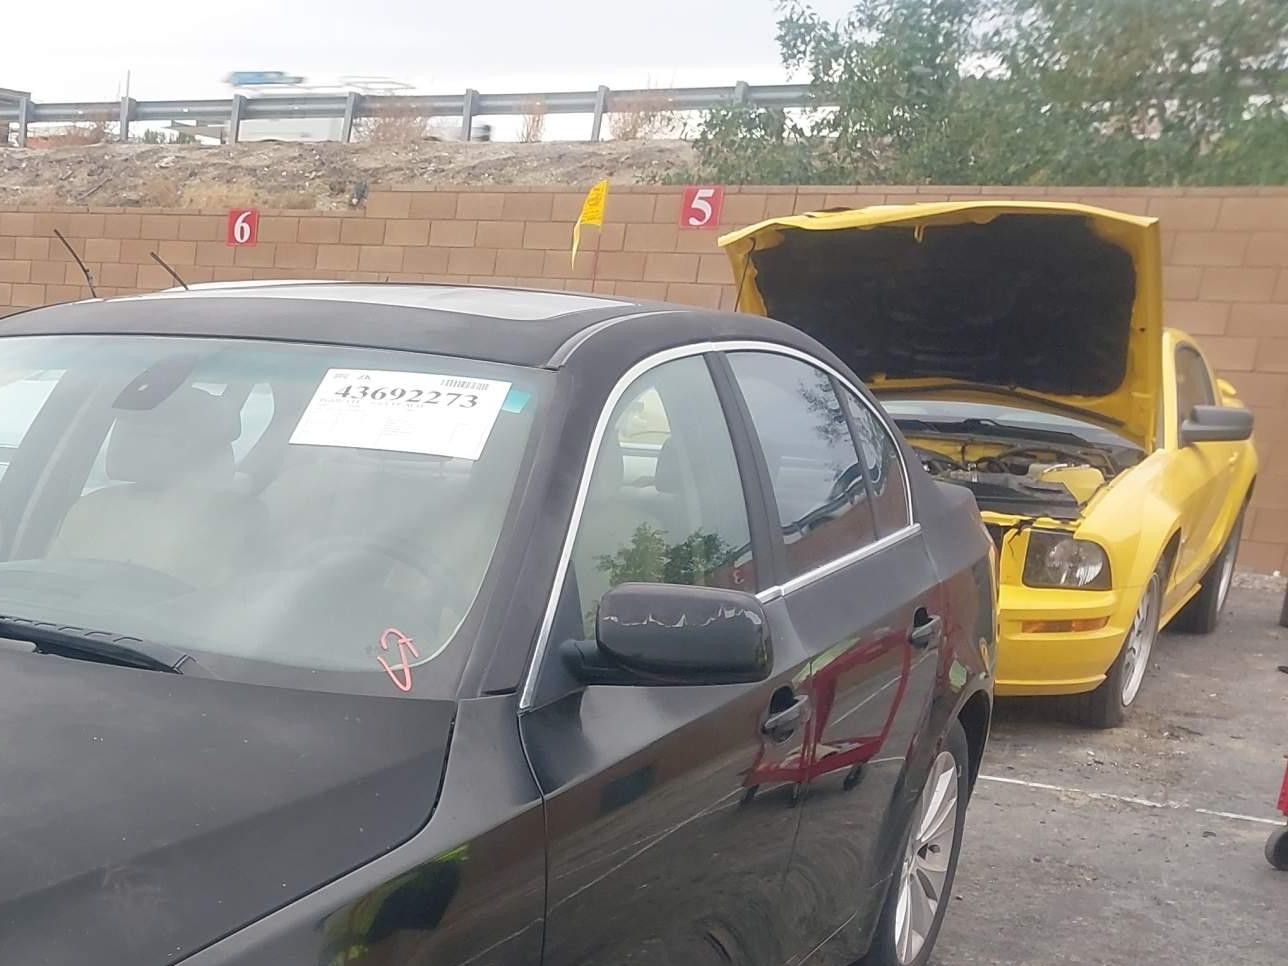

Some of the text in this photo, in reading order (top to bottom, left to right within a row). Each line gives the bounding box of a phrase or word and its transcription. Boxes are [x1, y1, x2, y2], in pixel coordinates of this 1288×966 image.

[688, 188, 714, 226] 5
[233, 211, 252, 243] 6
[333, 385, 479, 408] 43692273
